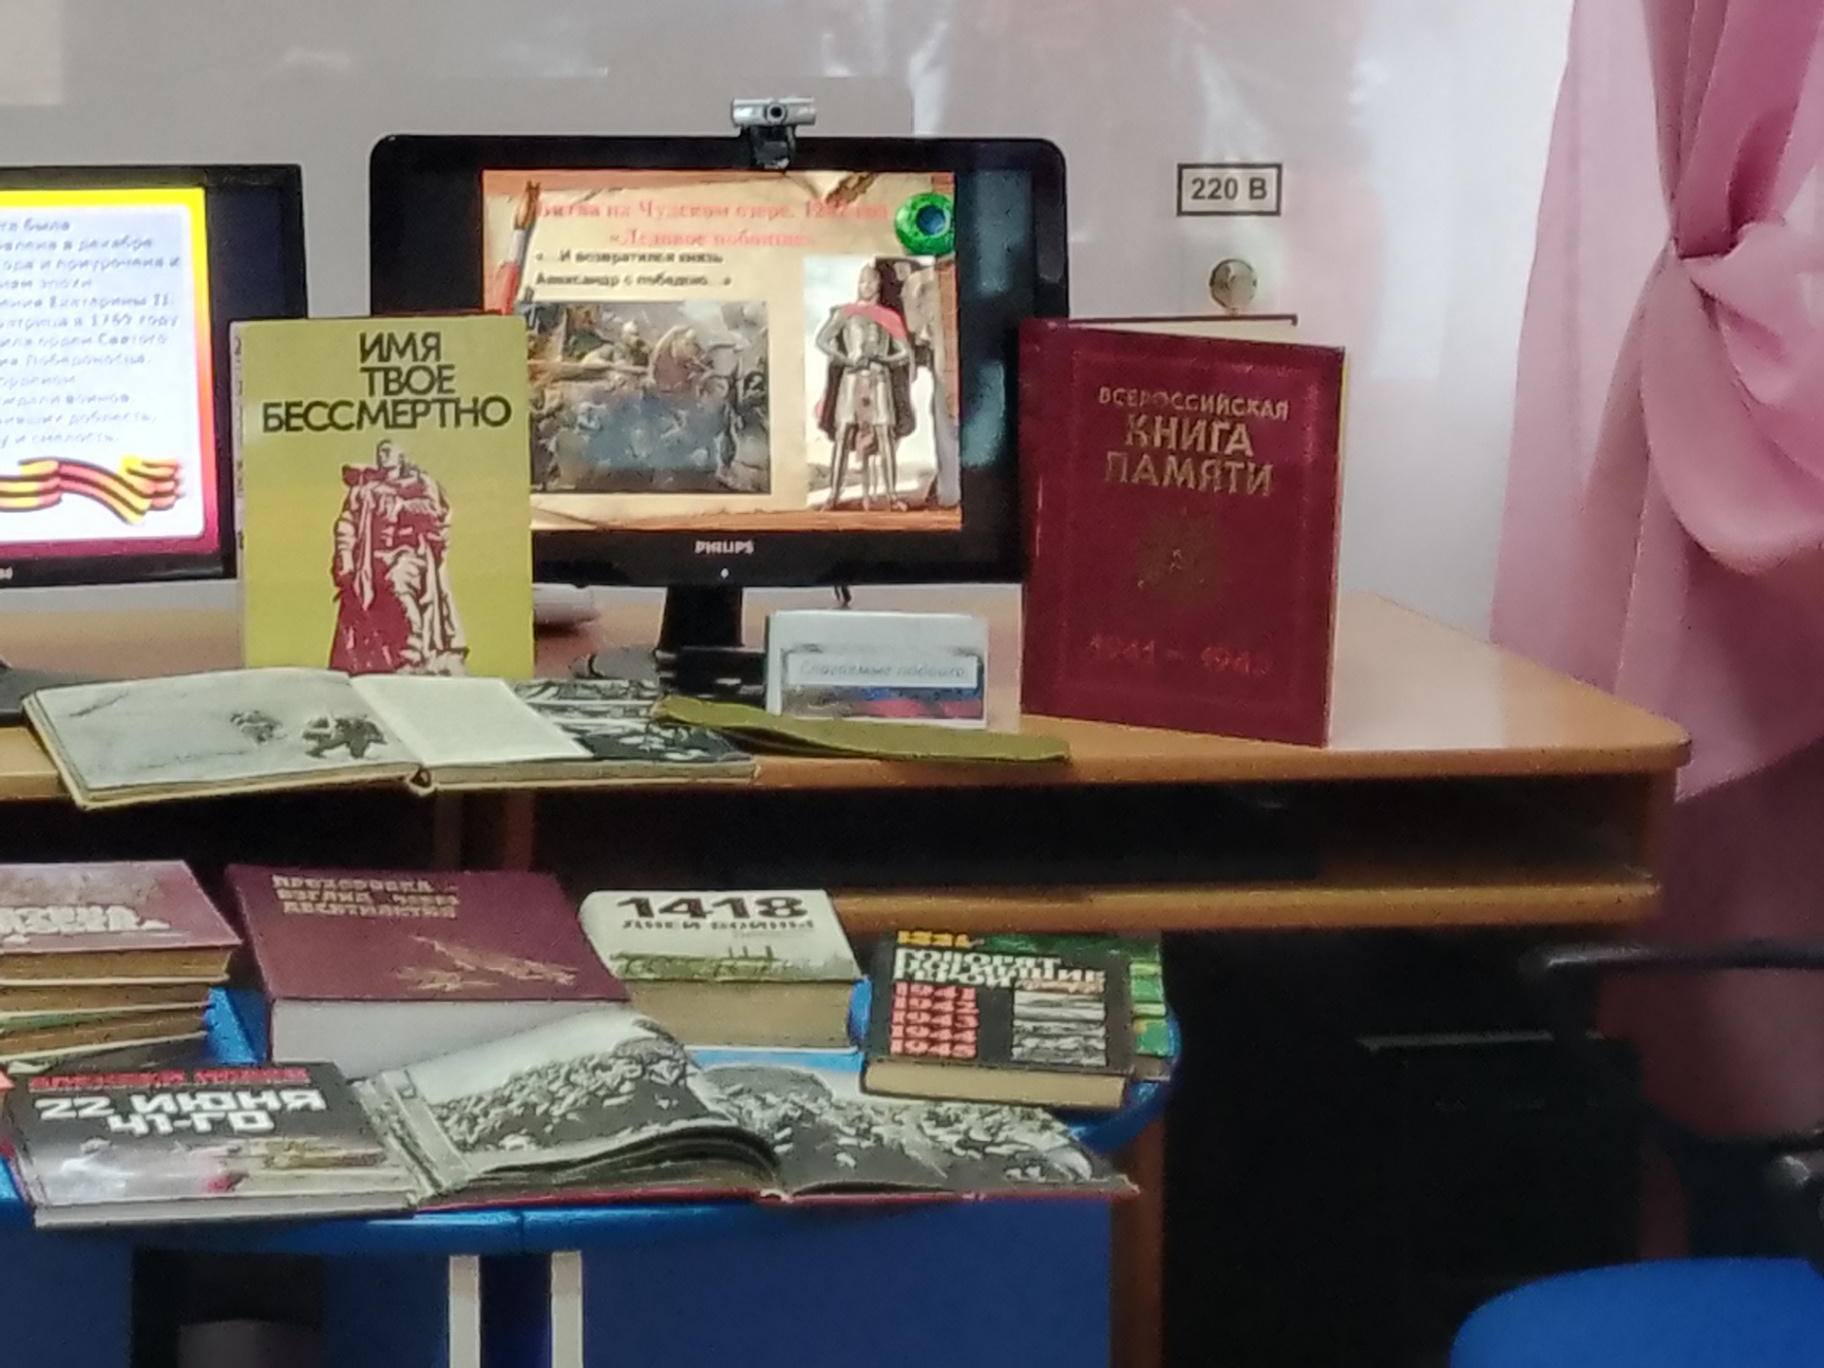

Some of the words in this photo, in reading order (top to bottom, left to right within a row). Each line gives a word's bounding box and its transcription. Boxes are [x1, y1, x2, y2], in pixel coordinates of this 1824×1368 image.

[1190, 176, 1240, 202] 220
[1248, 176, 1269, 202] В
[359, 331, 443, 363] ИМЯ
[360, 364, 456, 397] ТВОЕ
[262, 393, 513, 434] БЕССМЕРТНО
[1098, 385, 1290, 423] ВСЕРОССИЙСКАЯ
[1125, 413, 1256, 459] КНИГА
[1104, 450, 1275, 498] ПАМЯТИ
[694, 540, 755, 555] PHILIPS
[616, 895, 809, 920] 1418
[896, 981, 976, 1000] 1941
[34, 1095, 115, 1120] 22
[130, 1088, 327, 1115] ИЮНЯ
[107, 1108, 275, 1136] 41-ГО
